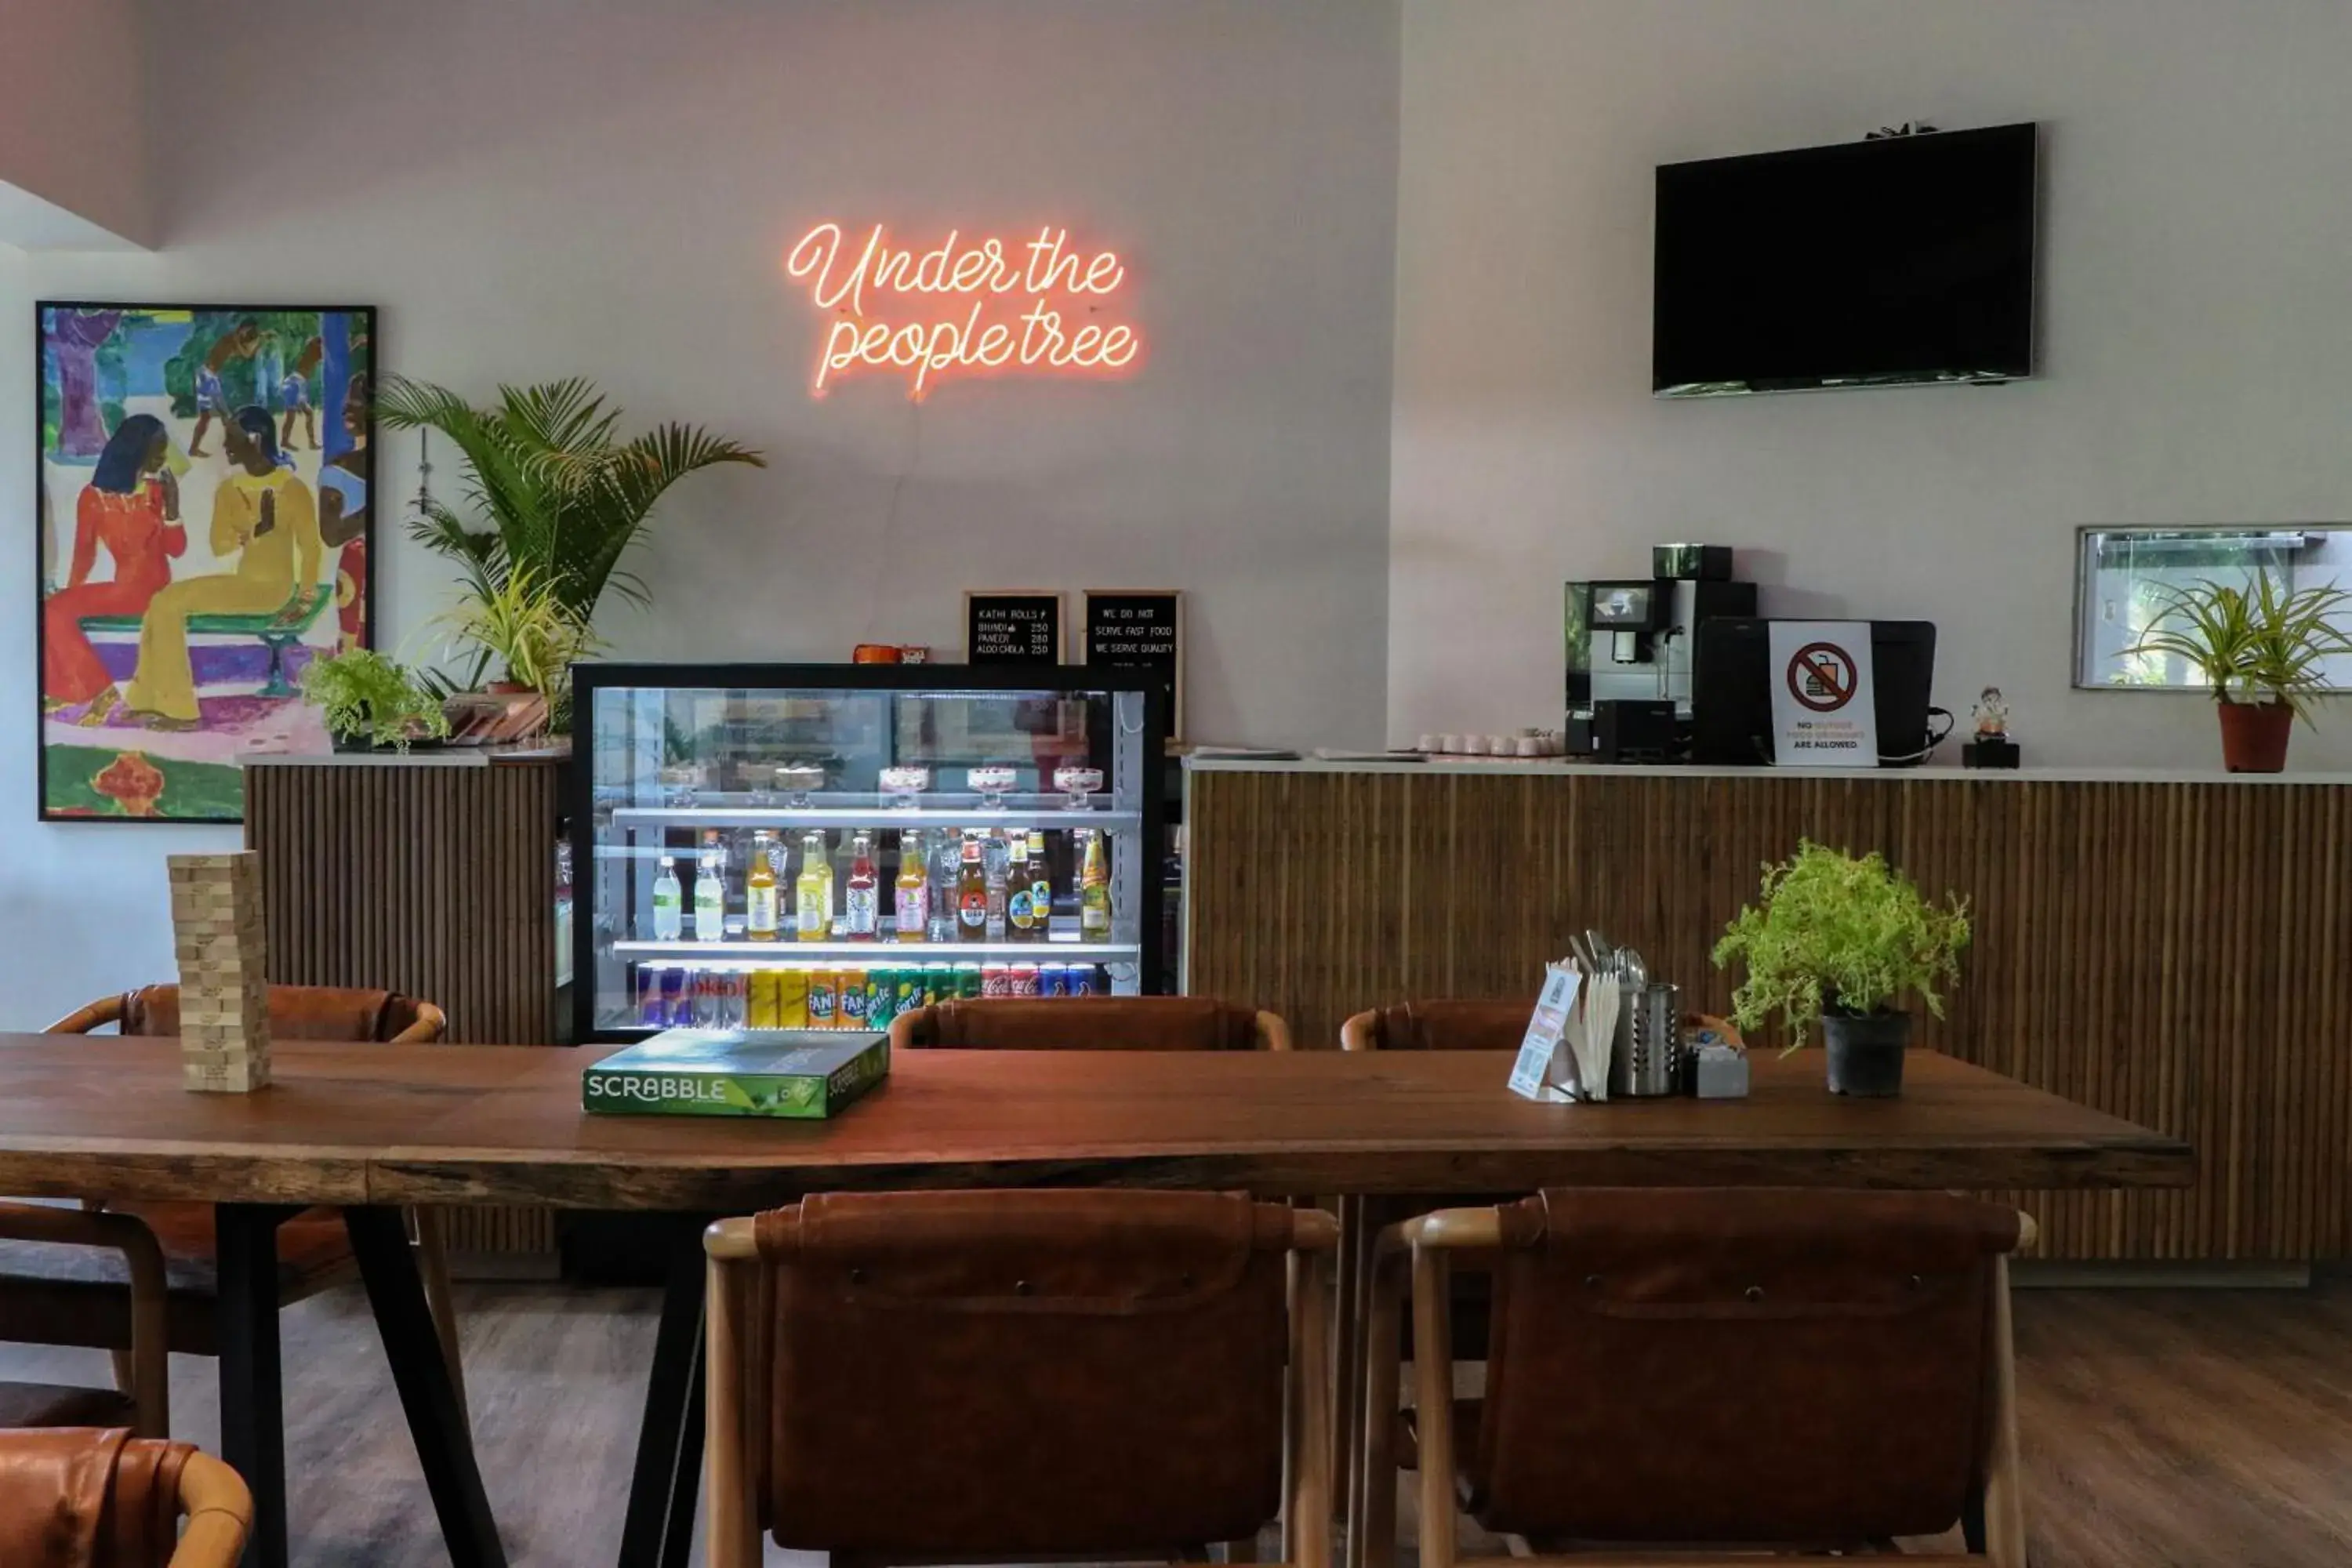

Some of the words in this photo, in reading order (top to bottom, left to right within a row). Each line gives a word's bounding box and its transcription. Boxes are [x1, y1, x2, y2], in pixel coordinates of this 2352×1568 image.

[787, 223, 1020, 316] Under
[1025, 226, 1124, 294] the
[815, 301, 1015, 391] people
[1020, 299, 1138, 366] tree
[978, 610, 1006, 619] KATHI
[1011, 610, 1037, 620] ROLLS
[1103, 609, 1116, 619] WE
[1120, 609, 1133, 619] DO
[1138, 609, 1154, 619] NOT
[1095, 627, 1122, 636] SERVE
[1126, 627, 1145, 636] FAST
[1150, 627, 1172, 637] FOOD
[1095, 644, 1108, 653] WE
[1110, 644, 1137, 653] SERVE
[589, 1076, 726, 1102] SCRABBLE
